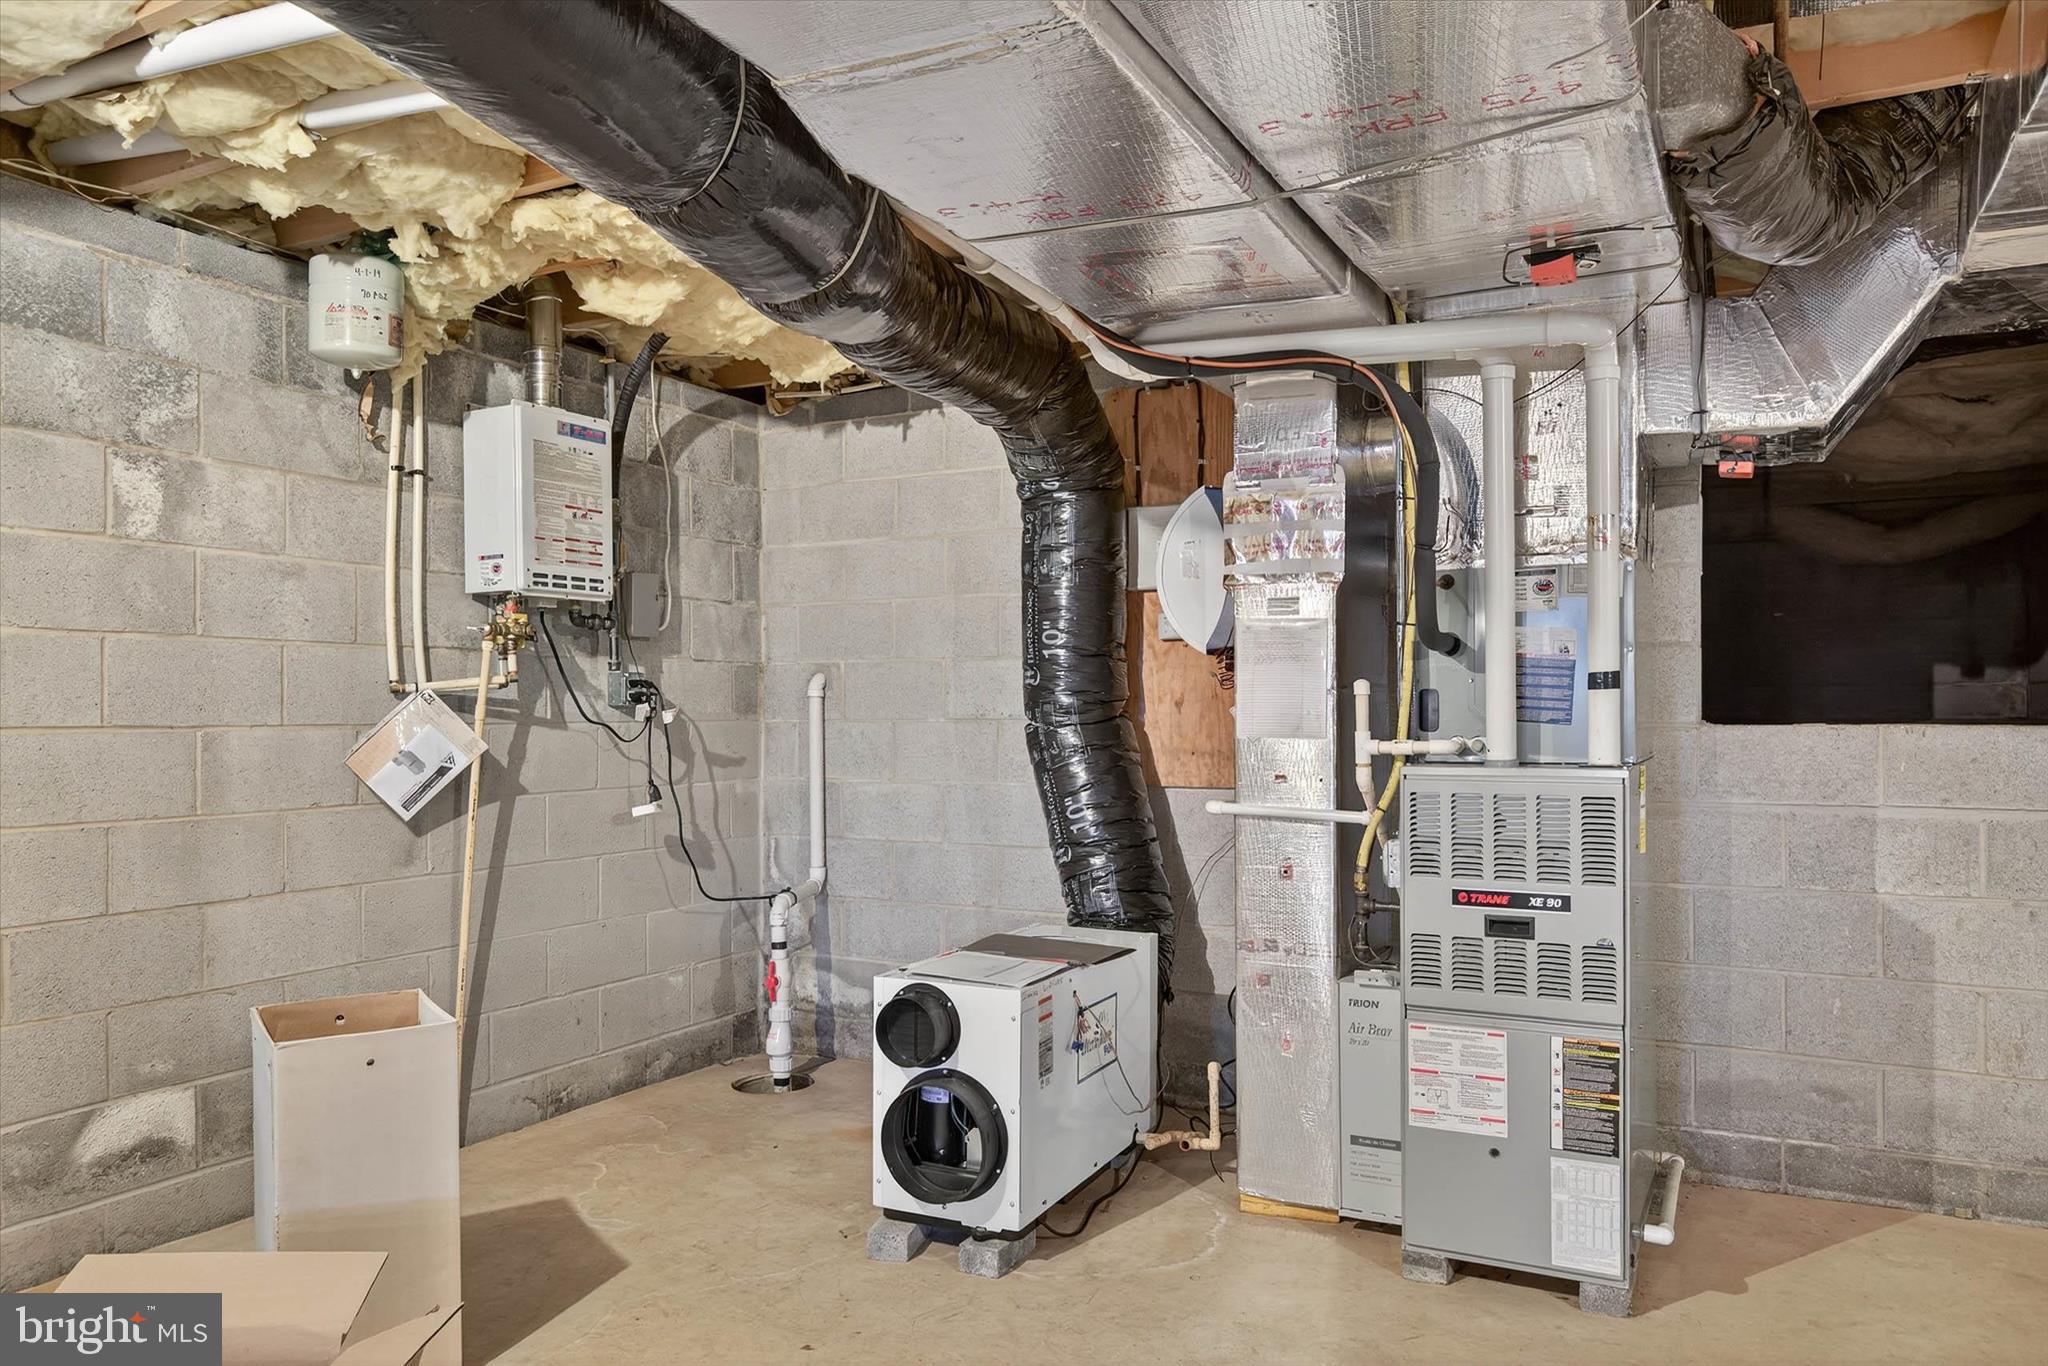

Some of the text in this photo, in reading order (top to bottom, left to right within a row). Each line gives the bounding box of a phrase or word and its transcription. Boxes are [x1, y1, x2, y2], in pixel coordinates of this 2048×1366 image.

[1042, 621, 1065, 659] 10"
[1469, 893, 1562, 908] TRANE XE 90
[1348, 998, 1379, 1009] TRION
[1348, 1022, 1365, 1033] Air
